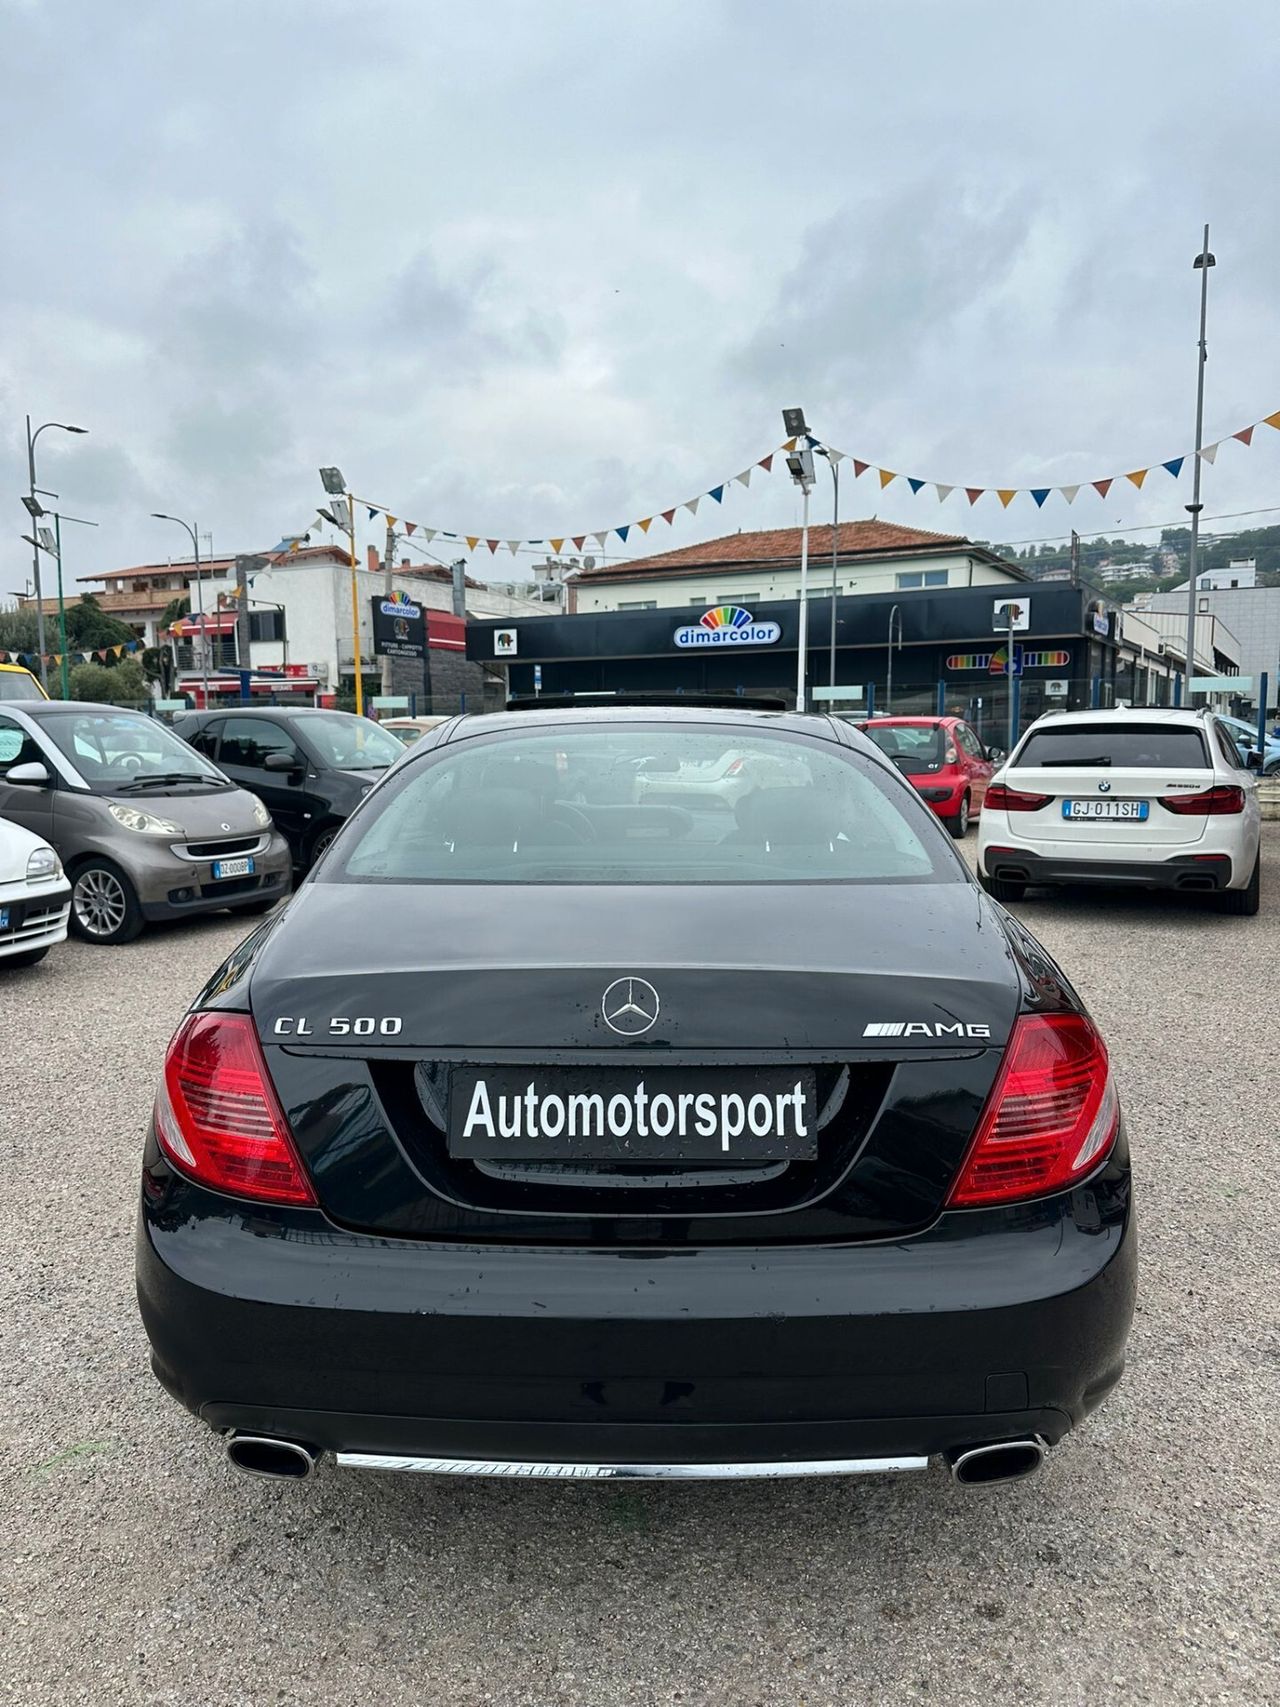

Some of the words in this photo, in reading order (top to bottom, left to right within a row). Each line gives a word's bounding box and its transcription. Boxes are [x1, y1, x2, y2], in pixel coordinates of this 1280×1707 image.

[382, 604, 418, 617] dimarcolor
[680, 627, 774, 644] dimarcolor
[274, 1017, 313, 1035] CL
[328, 1017, 402, 1035] 500
[903, 1022, 991, 1038] AMG
[462, 1080, 808, 1152] Automotorsport
